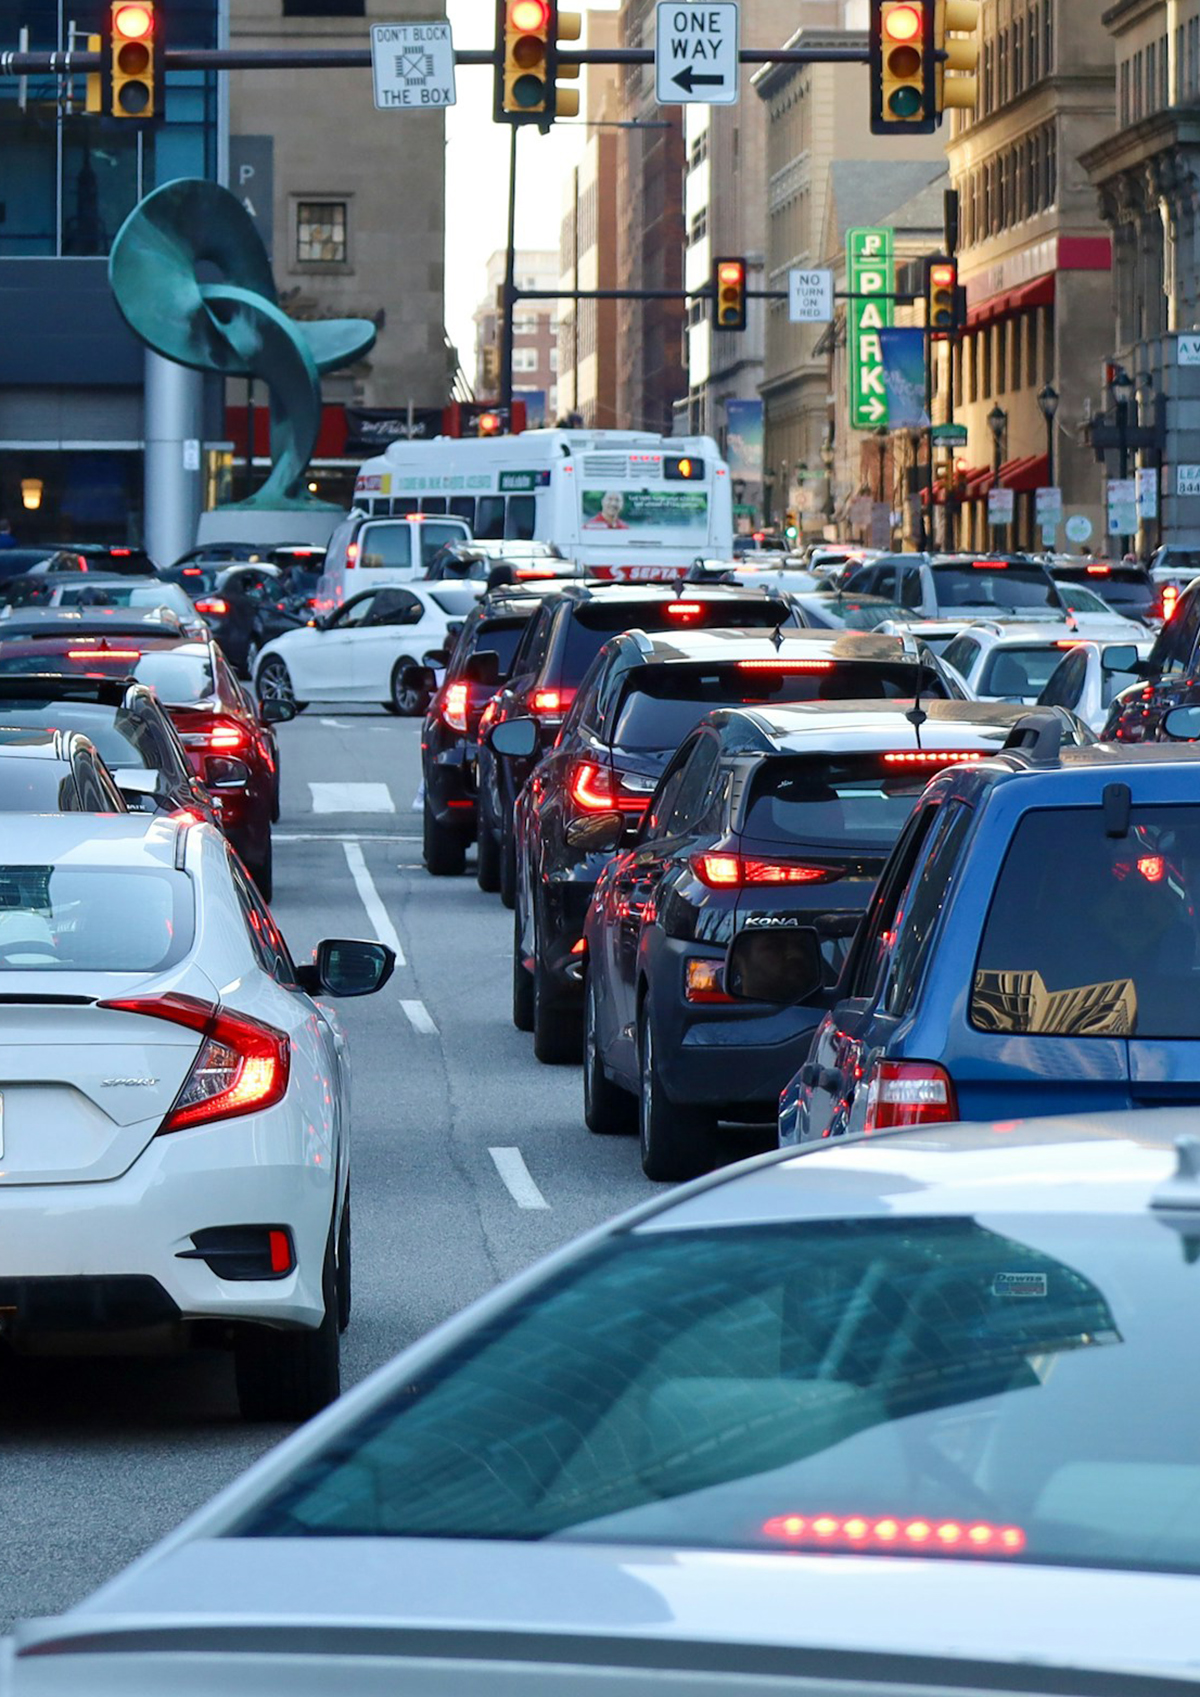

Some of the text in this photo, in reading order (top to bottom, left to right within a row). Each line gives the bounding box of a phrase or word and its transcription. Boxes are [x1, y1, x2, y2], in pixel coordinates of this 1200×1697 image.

[673, 12, 721, 33] ONE
[377, 27, 448, 42] DON'T BLOCK
[671, 38, 723, 60] WAY
[382, 89, 451, 104] THE BOX
[800, 275, 820, 286] NO
[859, 272, 885, 394] PARK
[629, 567, 679, 579] SEPTA
[745, 917, 798, 926] KONA
[101, 1078, 159, 1088] SPORT
